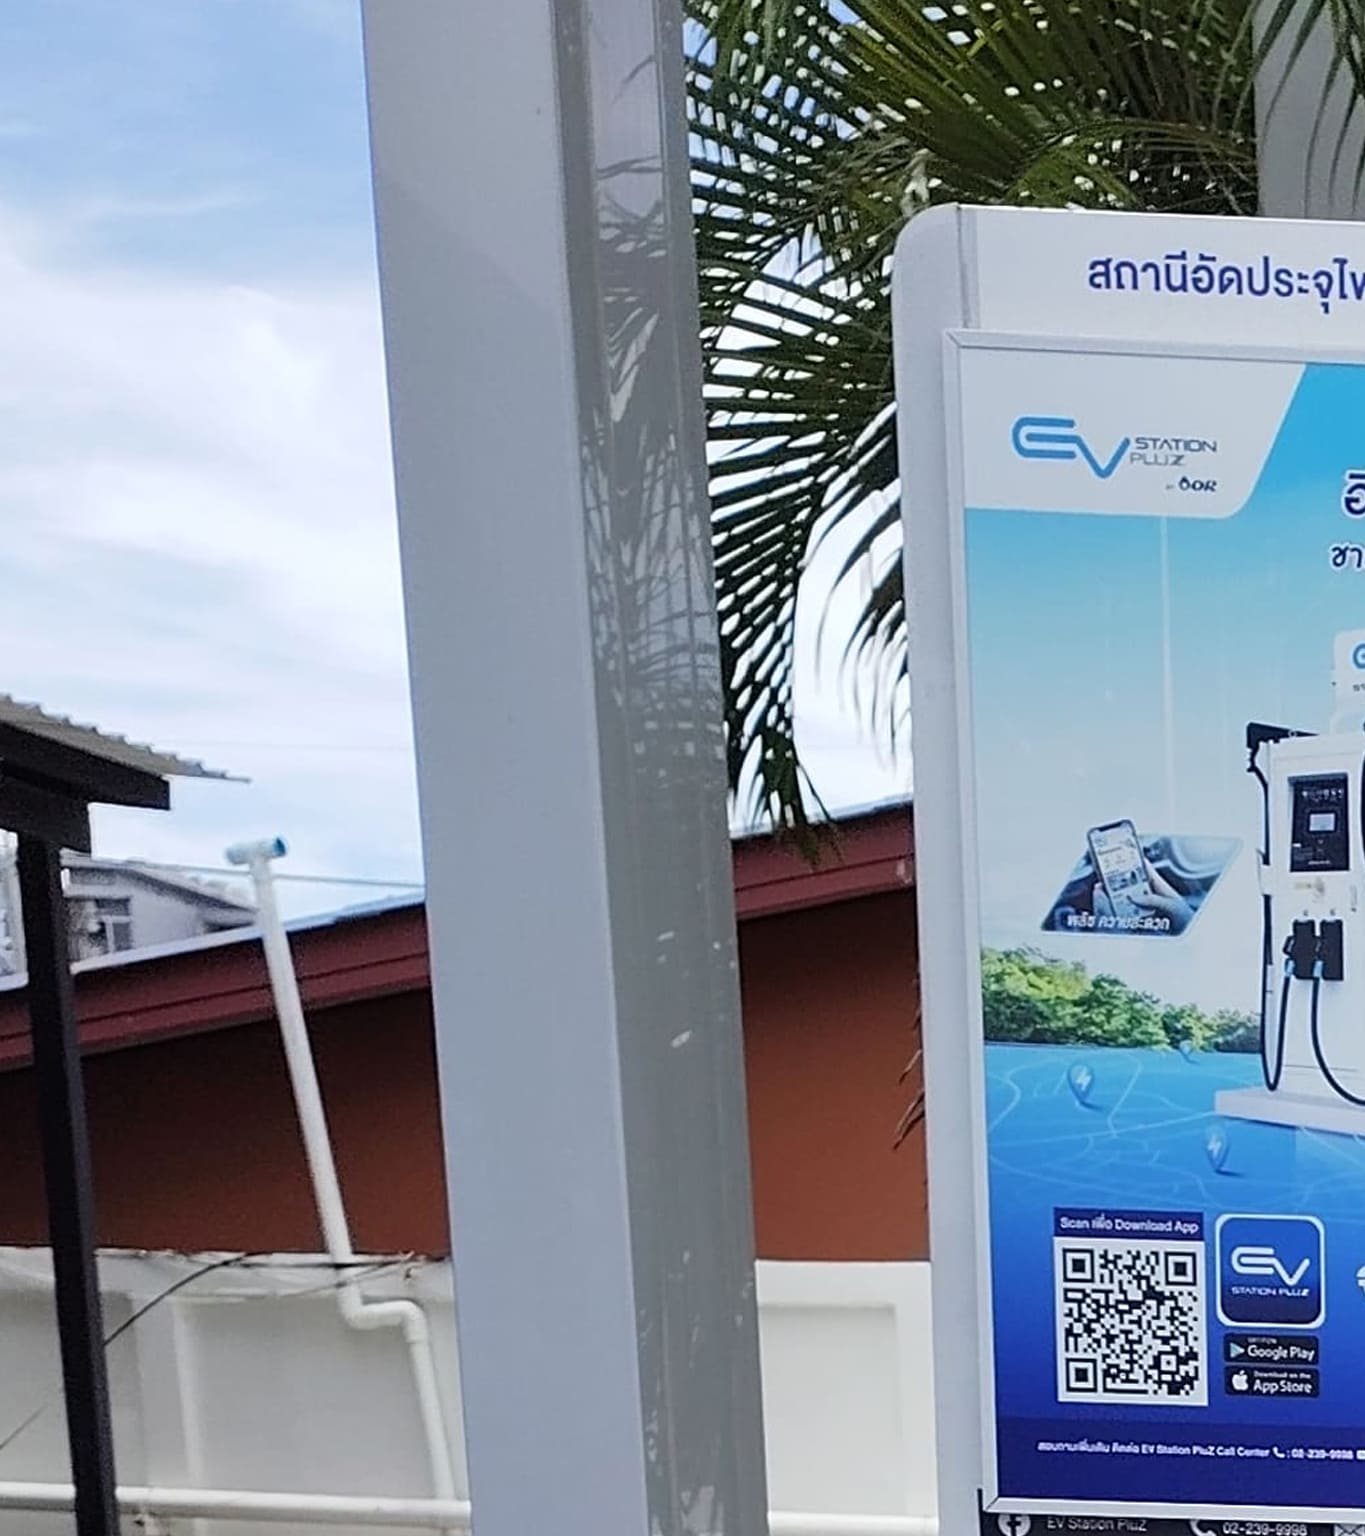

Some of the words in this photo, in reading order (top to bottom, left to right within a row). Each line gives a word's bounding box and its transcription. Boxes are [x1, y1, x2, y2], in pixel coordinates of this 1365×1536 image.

[1012, 417, 1133, 478] EV
[1135, 437, 1217, 452] STATION
[1130, 453, 1184, 466] PLUZ
[1061, 1217, 1089, 1228] Scan
[1115, 1219, 1174, 1231] Download
[1174, 1221, 1198, 1234] App
[1232, 1246, 1310, 1285] EV
[1247, 1344, 1288, 1360] Google
[1289, 1345, 1315, 1361] Play
[1253, 1379, 1279, 1394] App
[1280, 1380, 1312, 1394] Store
